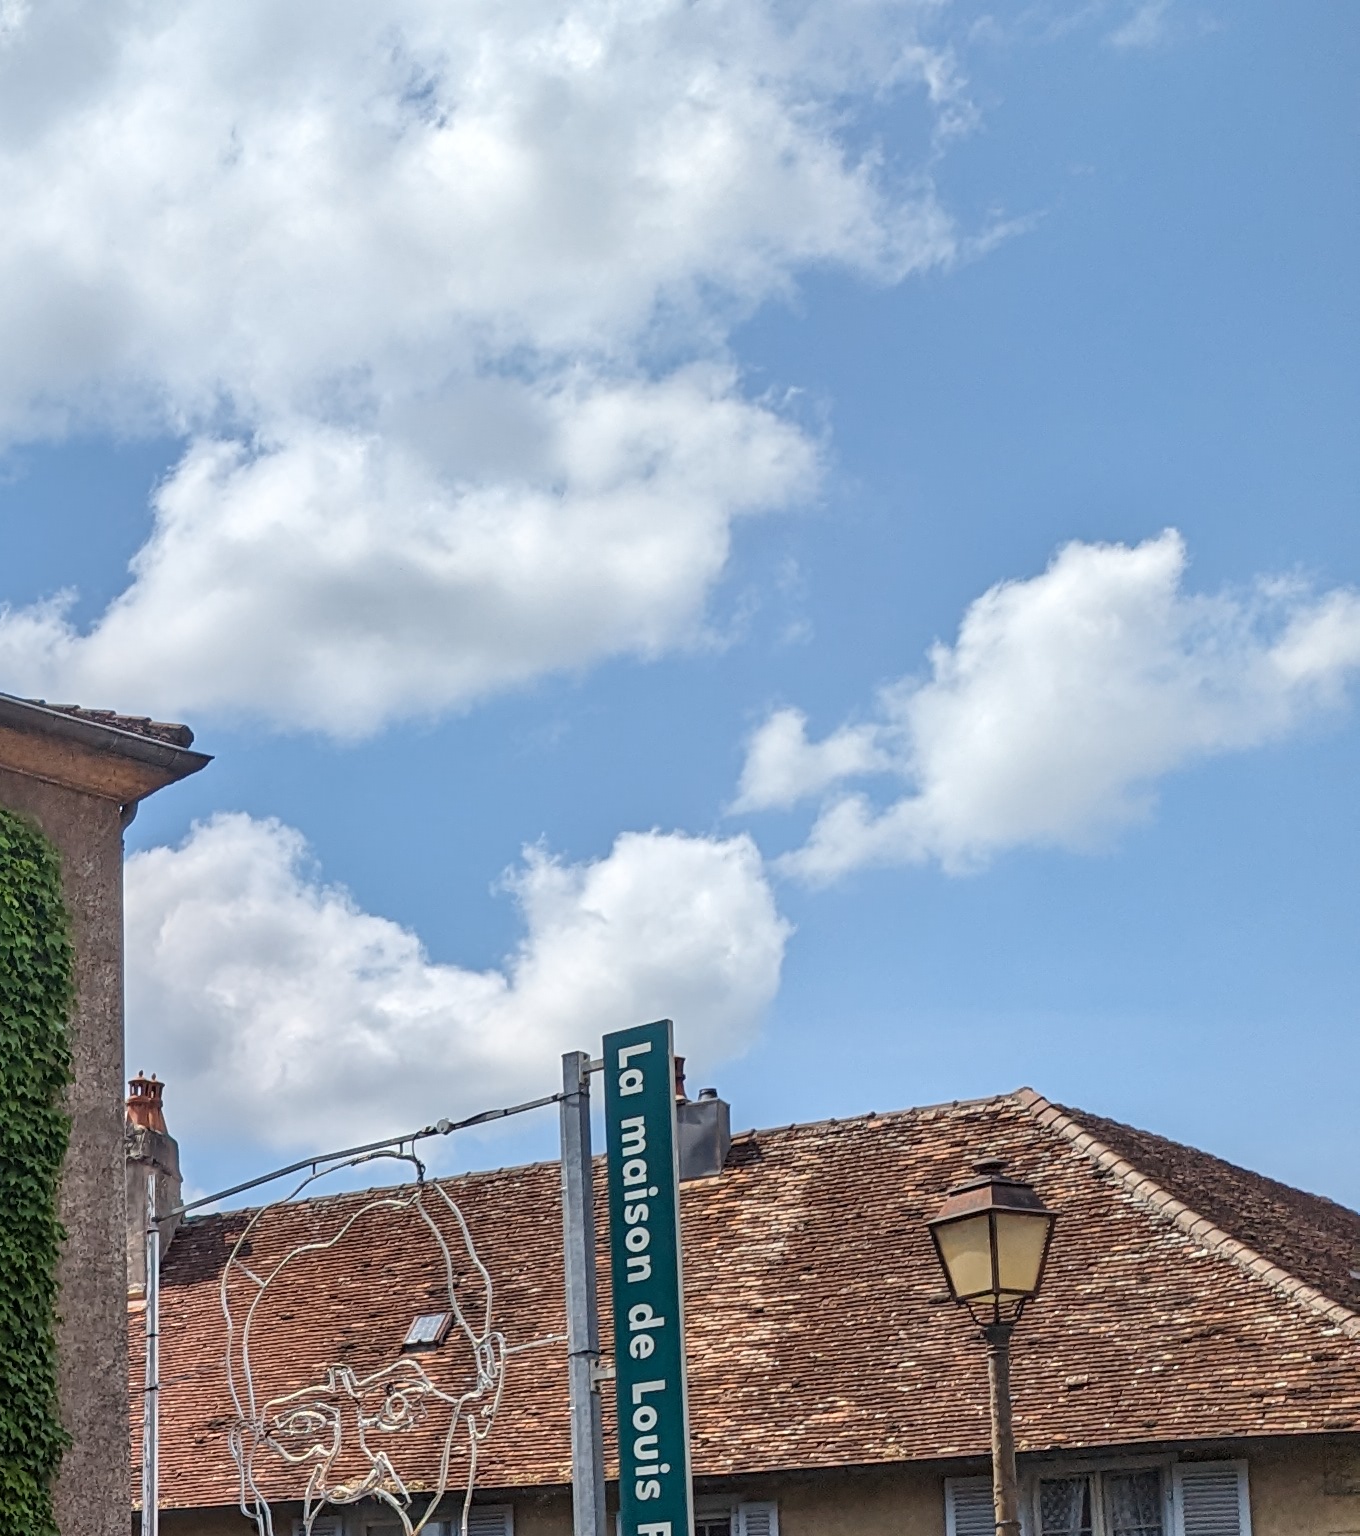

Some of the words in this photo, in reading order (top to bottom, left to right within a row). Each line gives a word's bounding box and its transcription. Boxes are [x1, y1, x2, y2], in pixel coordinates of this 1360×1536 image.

[617, 1040, 653, 1097] La
[620, 1115, 660, 1284] maison
[628, 1303, 666, 1360] de
[631, 1378, 671, 1502] Louis
